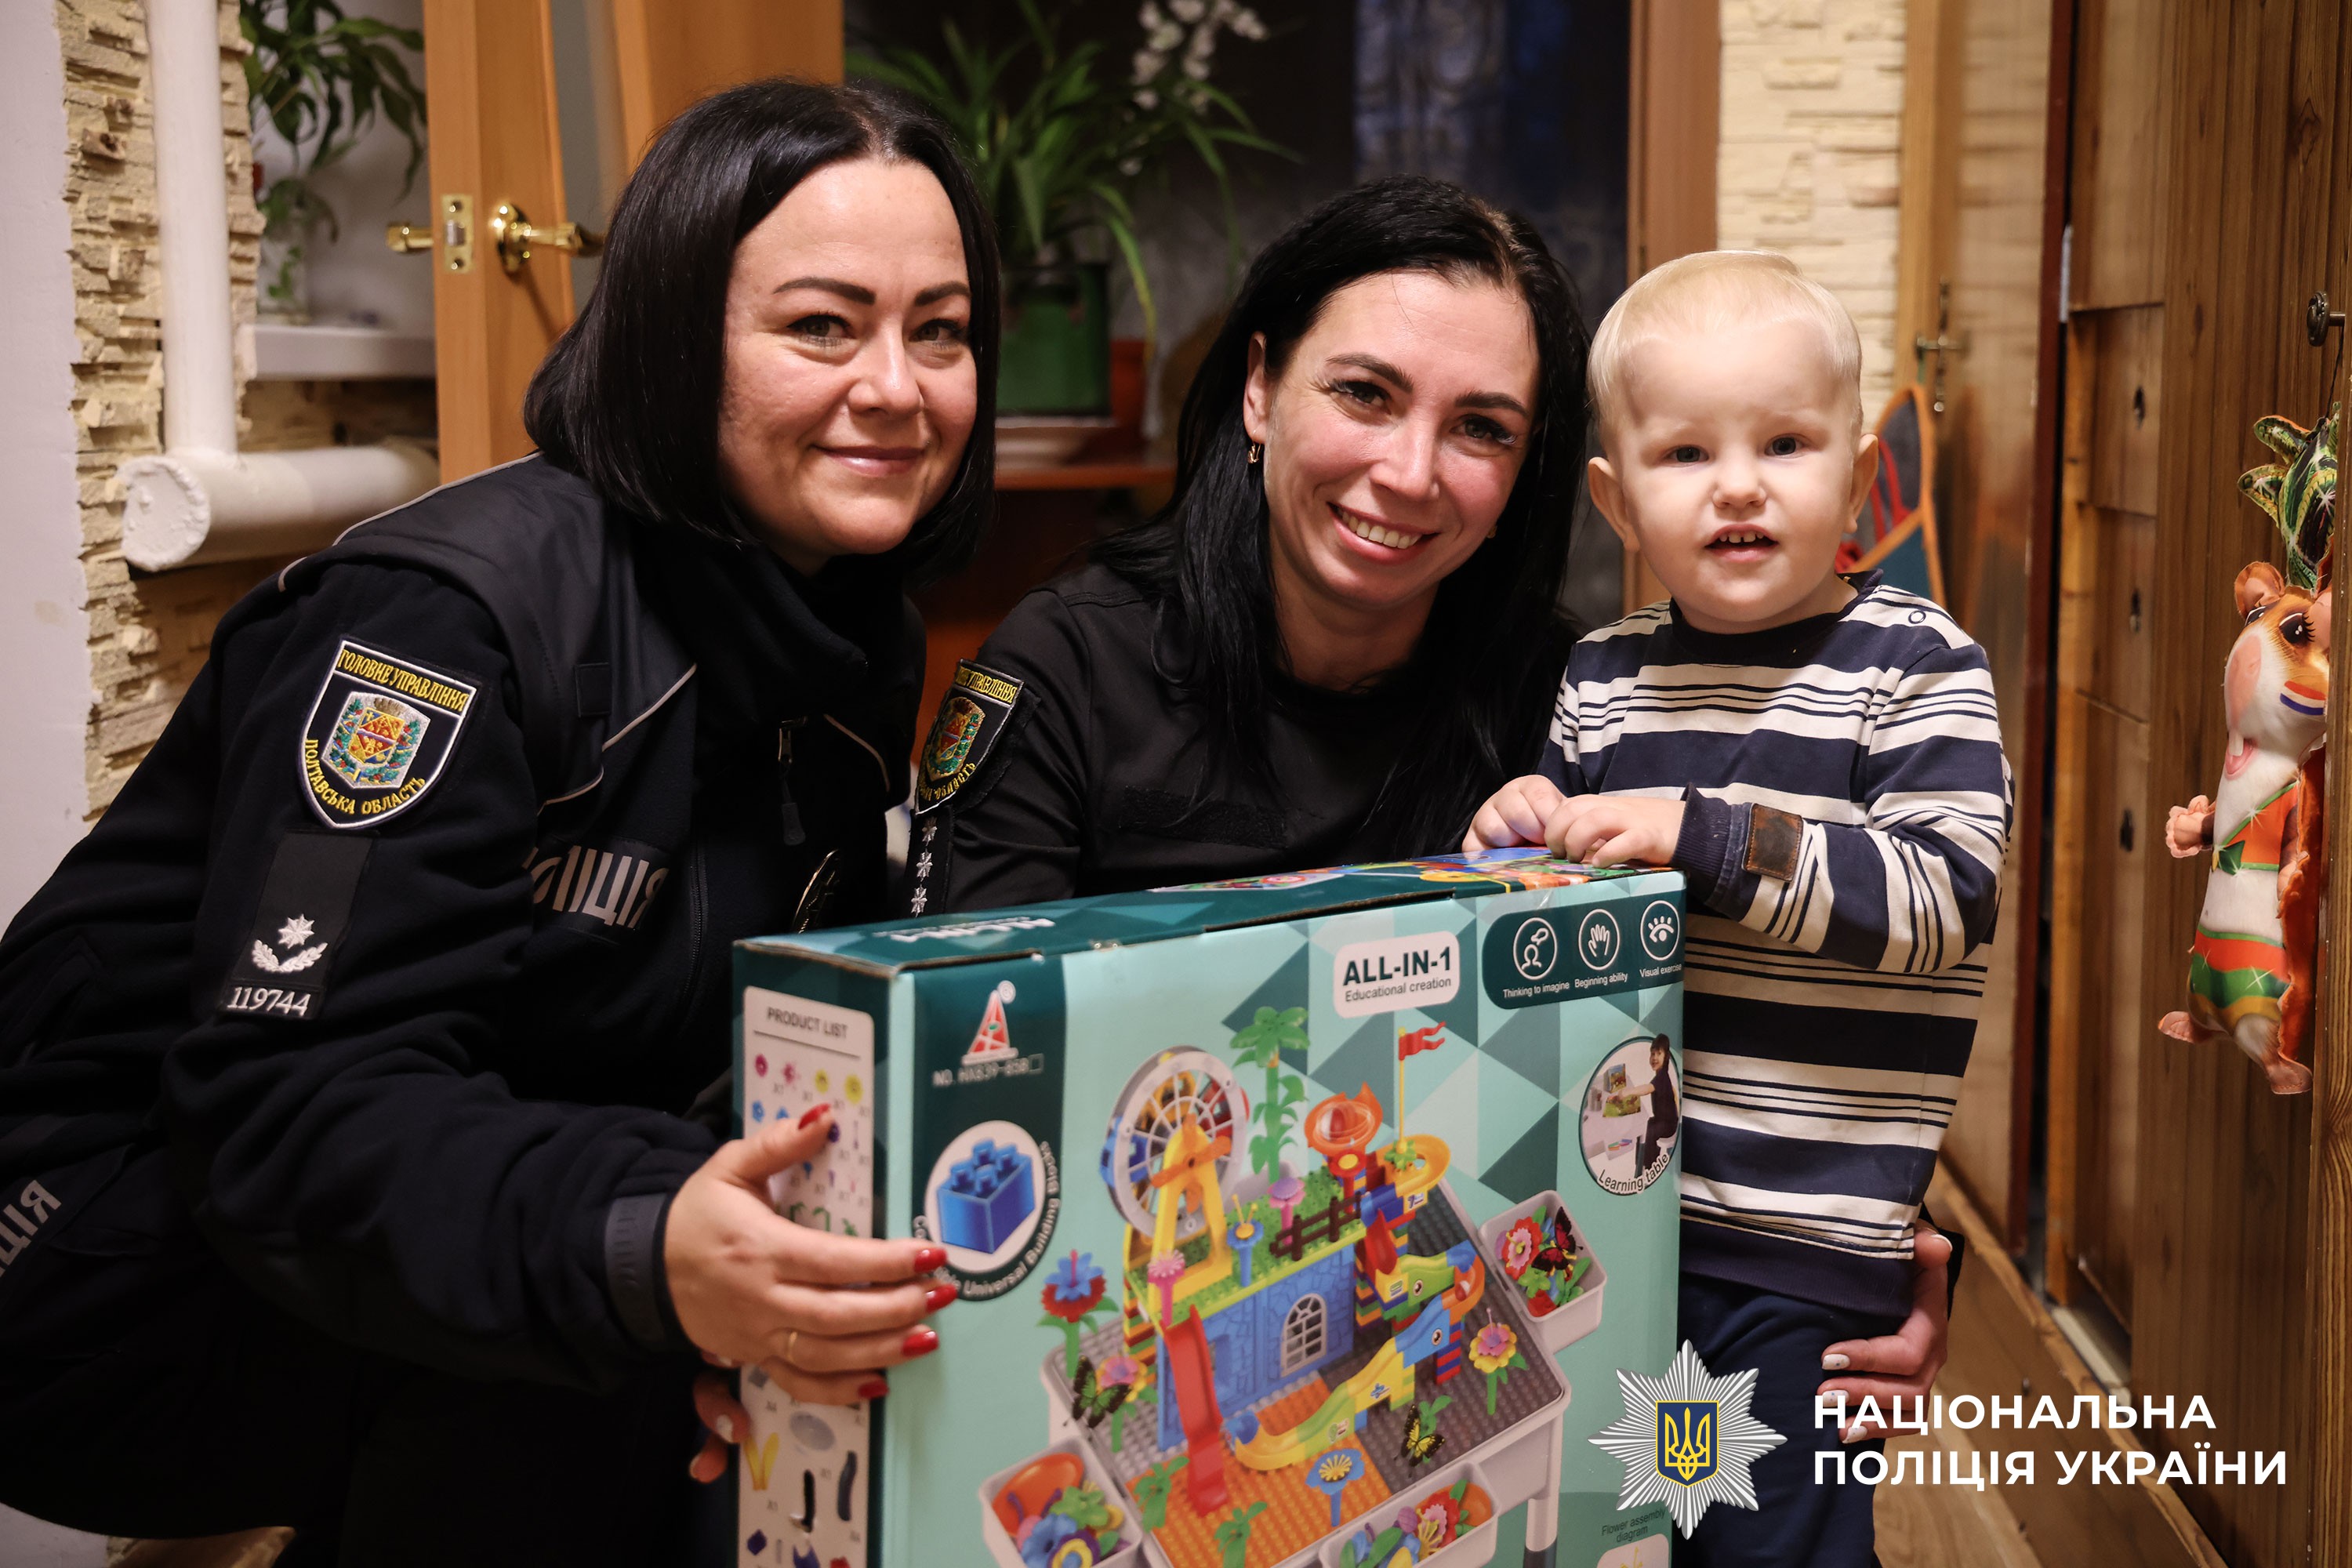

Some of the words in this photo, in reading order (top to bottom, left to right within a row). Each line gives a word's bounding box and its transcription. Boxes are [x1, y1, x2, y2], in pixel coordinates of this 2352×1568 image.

[337, 649, 394, 684] ГОЛОВНЕ
[388, 668, 469, 712] УПРАВЛІННЯ
[305, 739, 355, 814] ПОЛТАВСЬКА
[361, 777, 426, 815] ОБЛАСТЬ
[521, 845, 670, 929] ОЛІЦІЯ
[1343, 946, 1450, 986] ALL-IN-1
[1574, 975, 1608, 988] Beginning
[1609, 972, 1628, 982] ability
[1639, 969, 1660, 978] Visual
[1661, 964, 1682, 975] exercise
[227, 986, 311, 1016] 119744
[1345, 982, 1406, 1002] Educational
[1409, 978, 1451, 993] creation
[1503, 986, 1533, 998] Thinking
[1534, 985, 1541, 993] to
[1542, 981, 1570, 993] imagine
[766, 1007, 820, 1032] PRODUCT
[824, 1021, 848, 1038] LIST
[1040, 1141, 1058, 1195] Blocks
[1599, 1169, 1643, 1192] Learning
[1646, 1154, 1668, 1182] table
[1024, 1197, 1061, 1265] Building
[964, 1260, 1027, 1298] Universal
[1602, 1521, 1628, 1536] Flower
[1630, 1508, 1665, 1526] assembly
[1616, 1526, 1648, 1543] diagram
